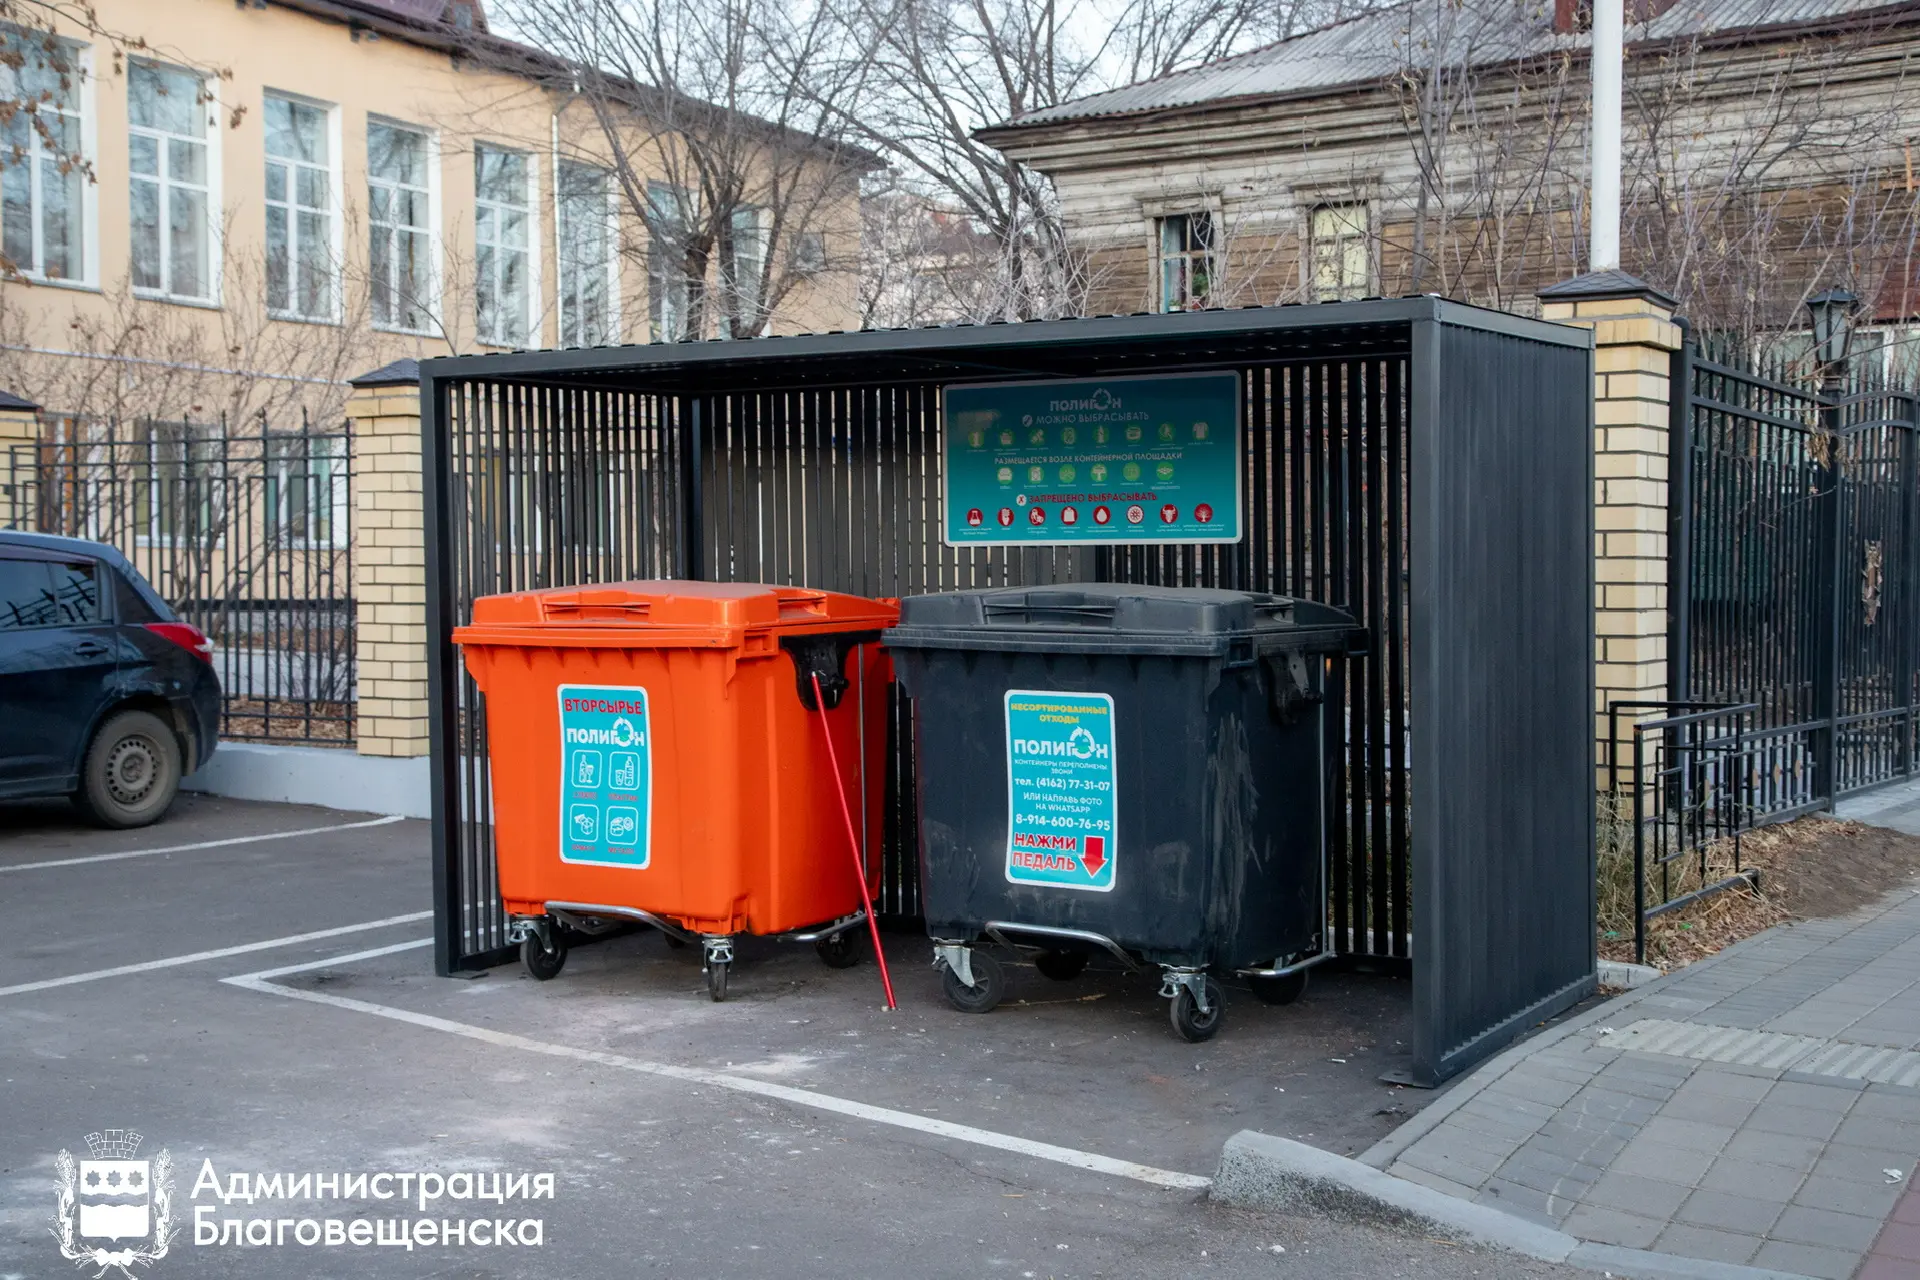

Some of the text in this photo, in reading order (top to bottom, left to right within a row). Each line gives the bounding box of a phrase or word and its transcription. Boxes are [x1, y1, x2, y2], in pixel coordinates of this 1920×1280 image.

[1036, 412, 1150, 425] МОЖНО ВЫБРАСЫВАТЬ
[994, 456, 1048, 465] РАЗМЕЩАЕТСЯ
[1074, 453, 1133, 463] КОНТЕЙНЕРНОЙ
[1135, 452, 1182, 461] ПЛОЩАДКИ
[1029, 492, 1158, 504] ЗАПРЕЩЕНО ВЫБРАСЫВАТЬ
[564, 698, 642, 715] ВТОРСЫРЬЕ
[1011, 703, 1108, 715] НЕСОРТИРОВАННЫЕ
[1039, 714, 1080, 724] ОТХОДЫ
[566, 716, 644, 747] ПОЛИГОН
[1014, 726, 1108, 759] ПОЛИГОН
[1015, 759, 1108, 770] КОНТЕЙНЕРЫ ПЕРЕПОЛНЕНЫ
[1015, 777, 1110, 791] тел. (4162) 77-31-07
[1023, 792, 1102, 806] ИЛИ НАПРАВЬ ФОТО
[1048, 804, 1090, 813] WHATSAPP
[1016, 814, 1111, 831] 8-914-600-76-95
[1014, 832, 1077, 851] НАЖМИ
[1012, 852, 1077, 872] ПЕДАЛЬ
